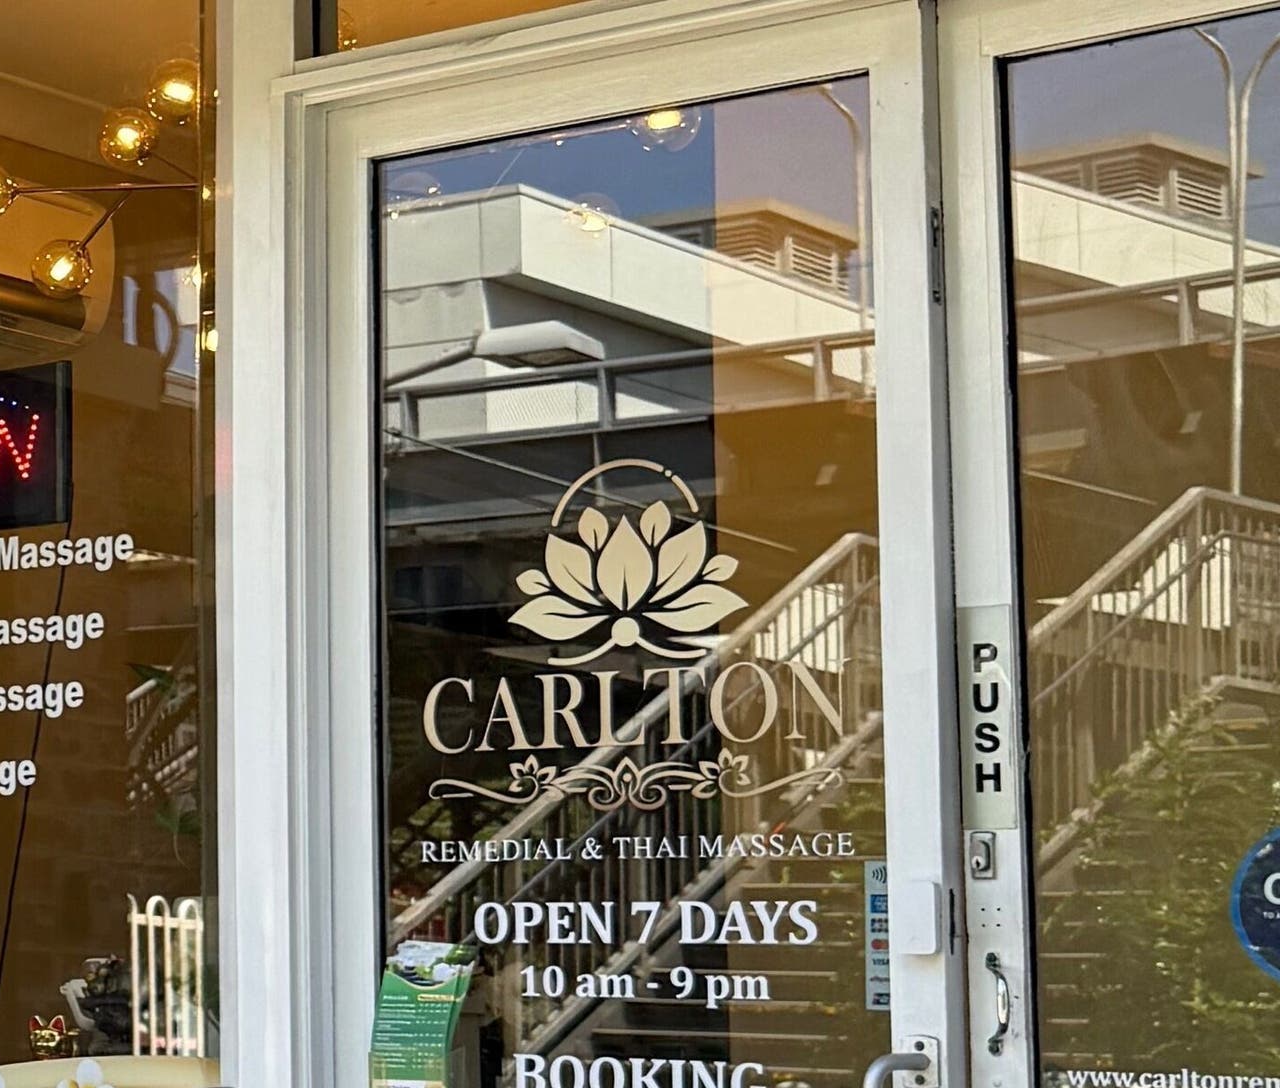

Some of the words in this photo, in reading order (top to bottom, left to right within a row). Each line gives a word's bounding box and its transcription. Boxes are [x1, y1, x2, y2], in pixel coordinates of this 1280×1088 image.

[422, 661, 845, 756] CARLTON
[972, 643, 1002, 793] PUSH
[421, 838, 571, 864] REMEDIAL
[581, 837, 603, 861] &
[613, 835, 688, 860] THAI
[699, 832, 855, 860] MASSAGE
[474, 901, 615, 946] OPEN
[631, 901, 662, 945] 7
[678, 900, 818, 946] DAYS
[519, 966, 571, 999] 10
[575, 971, 634, 1000] am
[669, 967, 694, 999] 9
[705, 974, 770, 1010] pm
